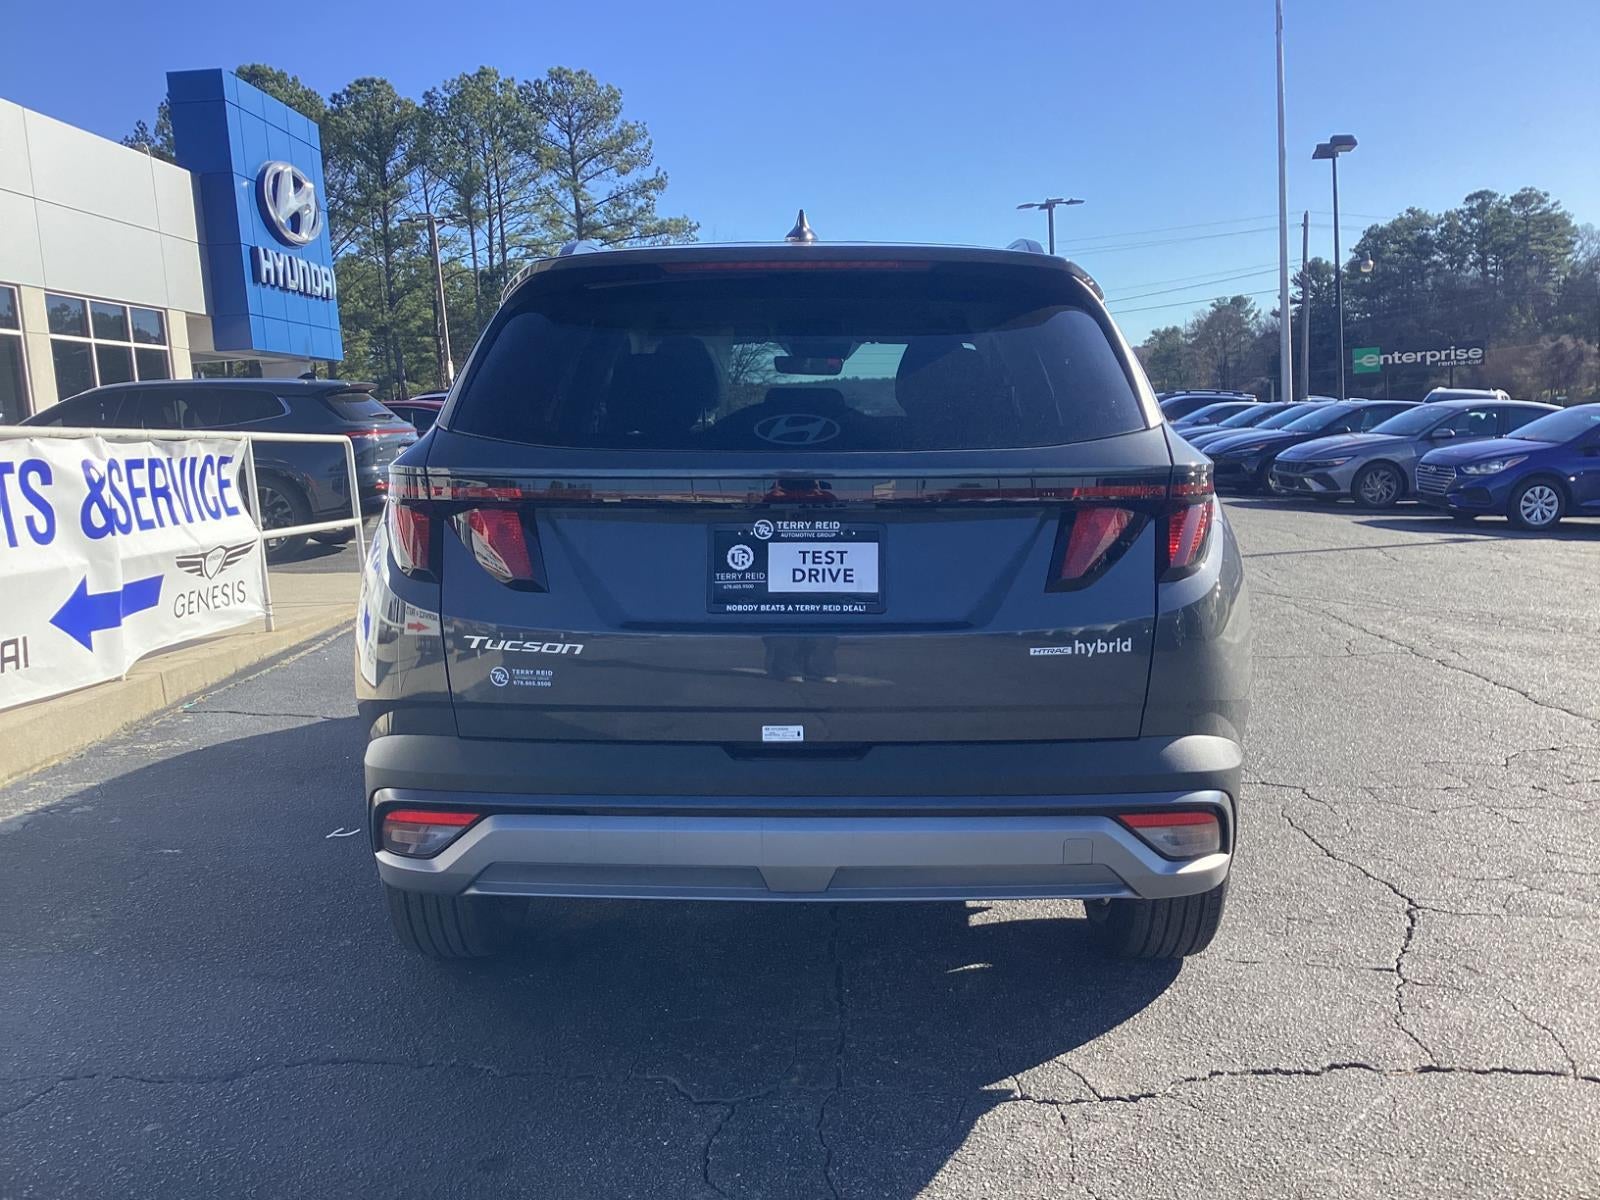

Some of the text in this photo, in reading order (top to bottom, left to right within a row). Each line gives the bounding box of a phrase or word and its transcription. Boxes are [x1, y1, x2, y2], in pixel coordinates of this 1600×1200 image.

[254, 246, 336, 300] HYUNDAI
[1354, 346, 1483, 366] enterprise
[1438, 359, 1482, 367] rent-a-car
[776, 521, 841, 529] TERRY REID
[798, 550, 848, 565] TEST
[715, 572, 766, 580] TERRY REID
[792, 568, 854, 583] DRIVE
[173, 580, 247, 619] GENESIS
[726, 604, 866, 612] NOBODY BEATS A TERRY REID DEAL!
[1031, 637, 1132, 657] HTRAC hybrid
